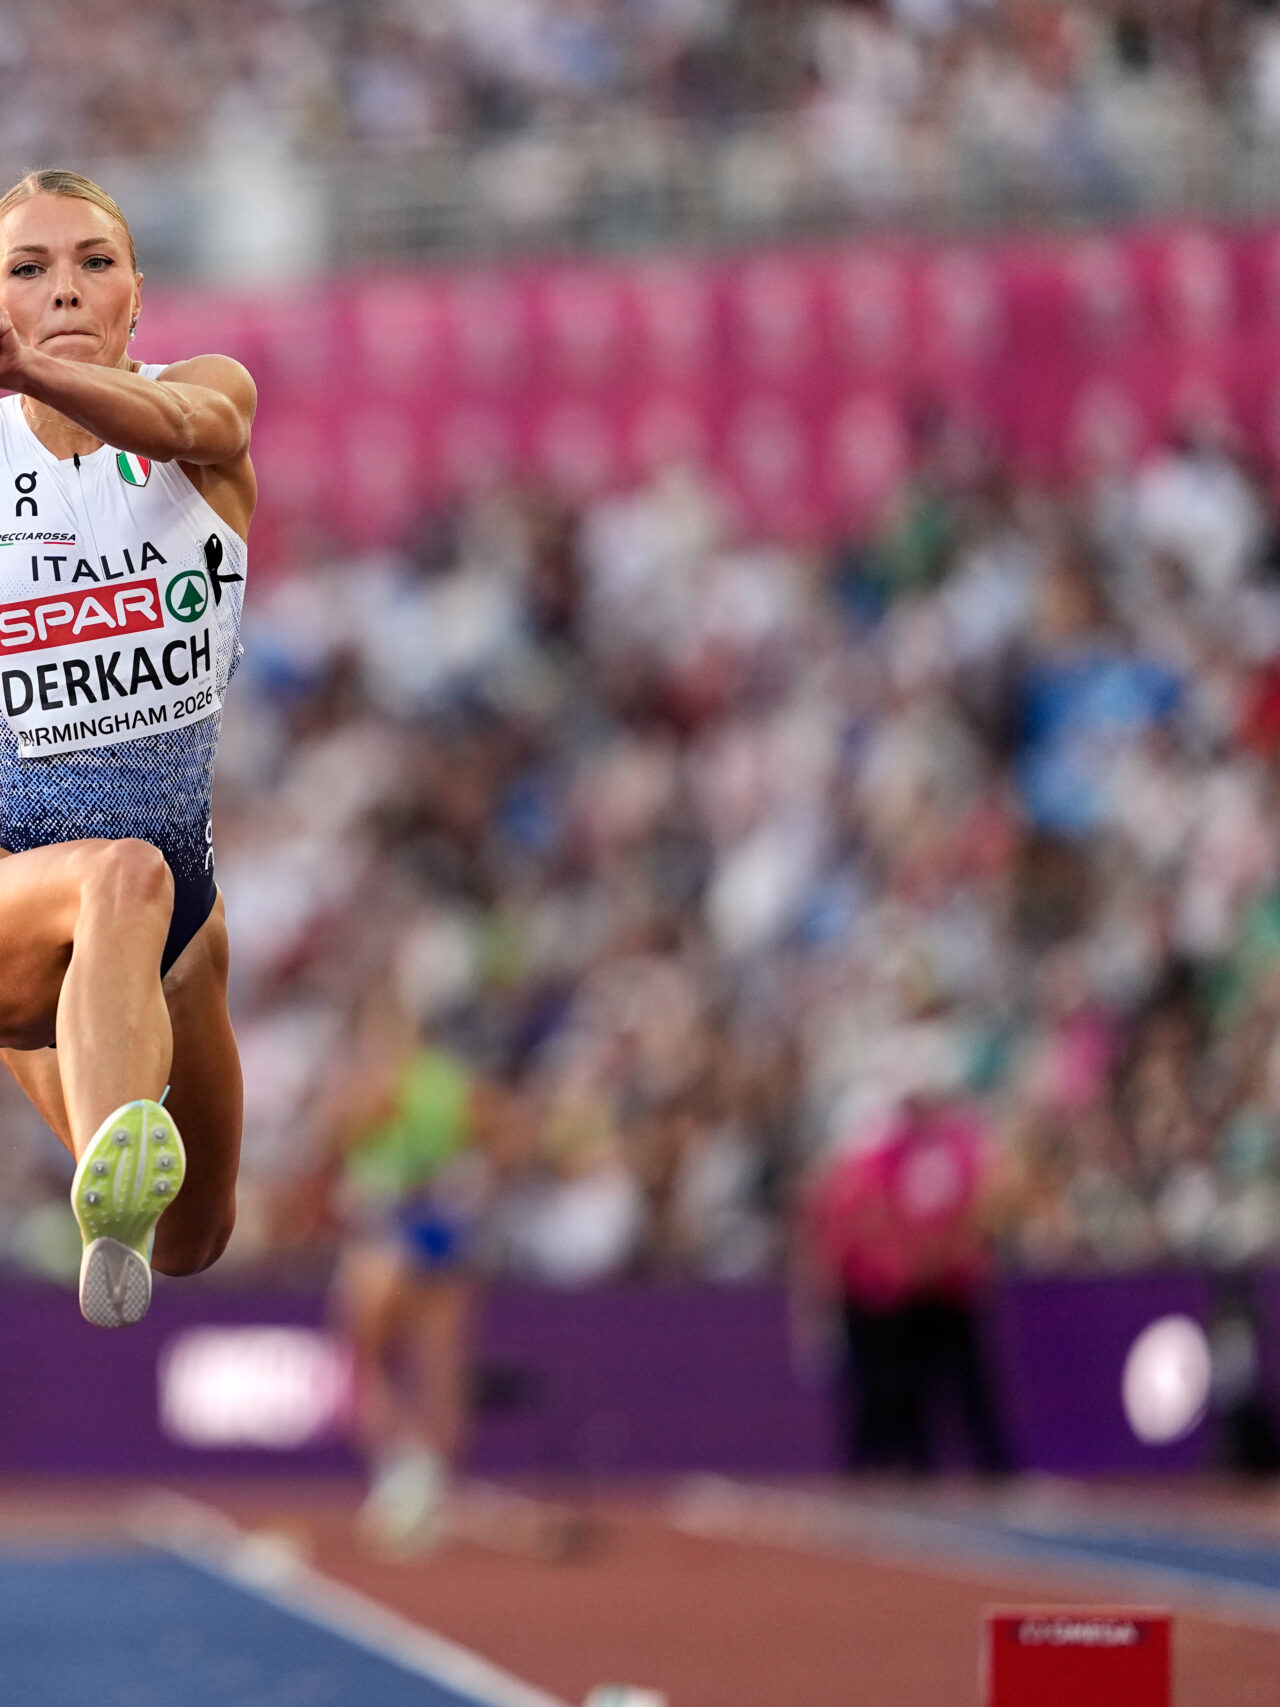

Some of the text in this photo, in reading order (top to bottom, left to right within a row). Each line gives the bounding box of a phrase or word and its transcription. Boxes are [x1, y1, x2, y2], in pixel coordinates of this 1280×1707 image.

[31, 541, 168, 583] ITALIA
[1, 628, 211, 717] DERKACH
[20, 686, 213, 747] BIRMINGHAM 2026
